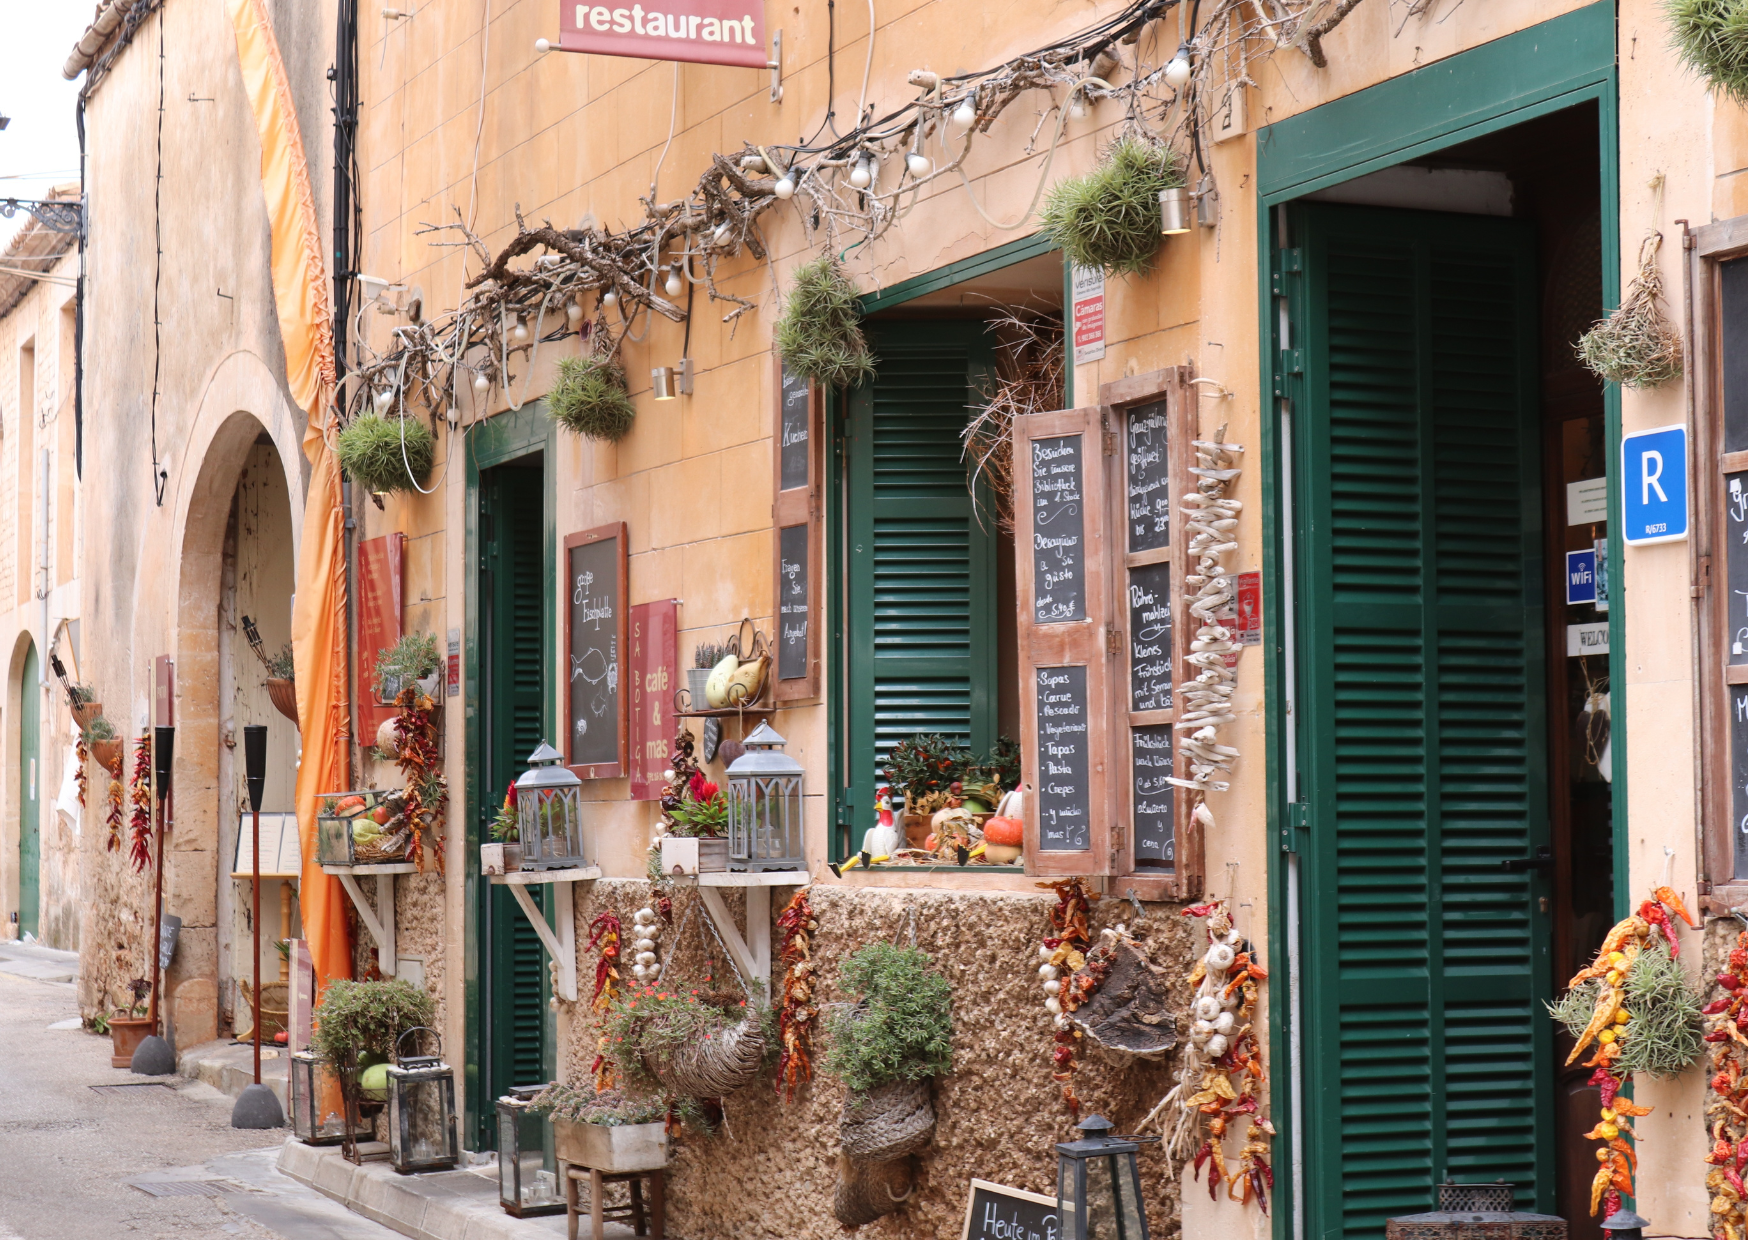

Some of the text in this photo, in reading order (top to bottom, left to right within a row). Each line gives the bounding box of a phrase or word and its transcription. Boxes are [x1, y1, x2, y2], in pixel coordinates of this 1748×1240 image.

[576, 3, 756, 45] restaurant
[1076, 302, 1103, 317] Cámaras
[782, 422, 808, 447] Kuchen
[1129, 408, 1168, 449] Ganzjähri
[1033, 461, 1048, 477] Sie
[1641, 449, 1668, 505] R
[1034, 476, 1077, 494] Bibliothek
[1036, 496, 1049, 507] im
[1063, 491, 1081, 502] Stock
[1135, 524, 1145, 536] bis
[1645, 522, 1667, 535] R/6733
[781, 558, 800, 579] Fragen
[1571, 570, 1592, 586] WiFi
[582, 595, 612, 631] Fischplatte
[1142, 602, 1171, 624] mahlzei
[1580, 629, 1609, 647] WELCO
[1133, 642, 1162, 659] Kleines
[645, 665, 668, 693] café
[1039, 672, 1070, 688] Sopas
[1134, 679, 1173, 699] mit Serran
[1043, 703, 1080, 717] Pescado
[1139, 696, 1156, 709] und
[652, 700, 662, 726] &
[646, 738, 669, 760] mas
[1045, 742, 1075, 756] Tapas
[1133, 733, 1171, 749] Frühstück
[1046, 760, 1072, 775] Pasta
[1135, 754, 1153, 767] nach
[1047, 782, 1075, 800] Crepes
[1143, 779, 1152, 789] ab
[1157, 820, 1164, 832] y
[1142, 839, 1160, 849] cena
[983, 1201, 1025, 1240] Heute
